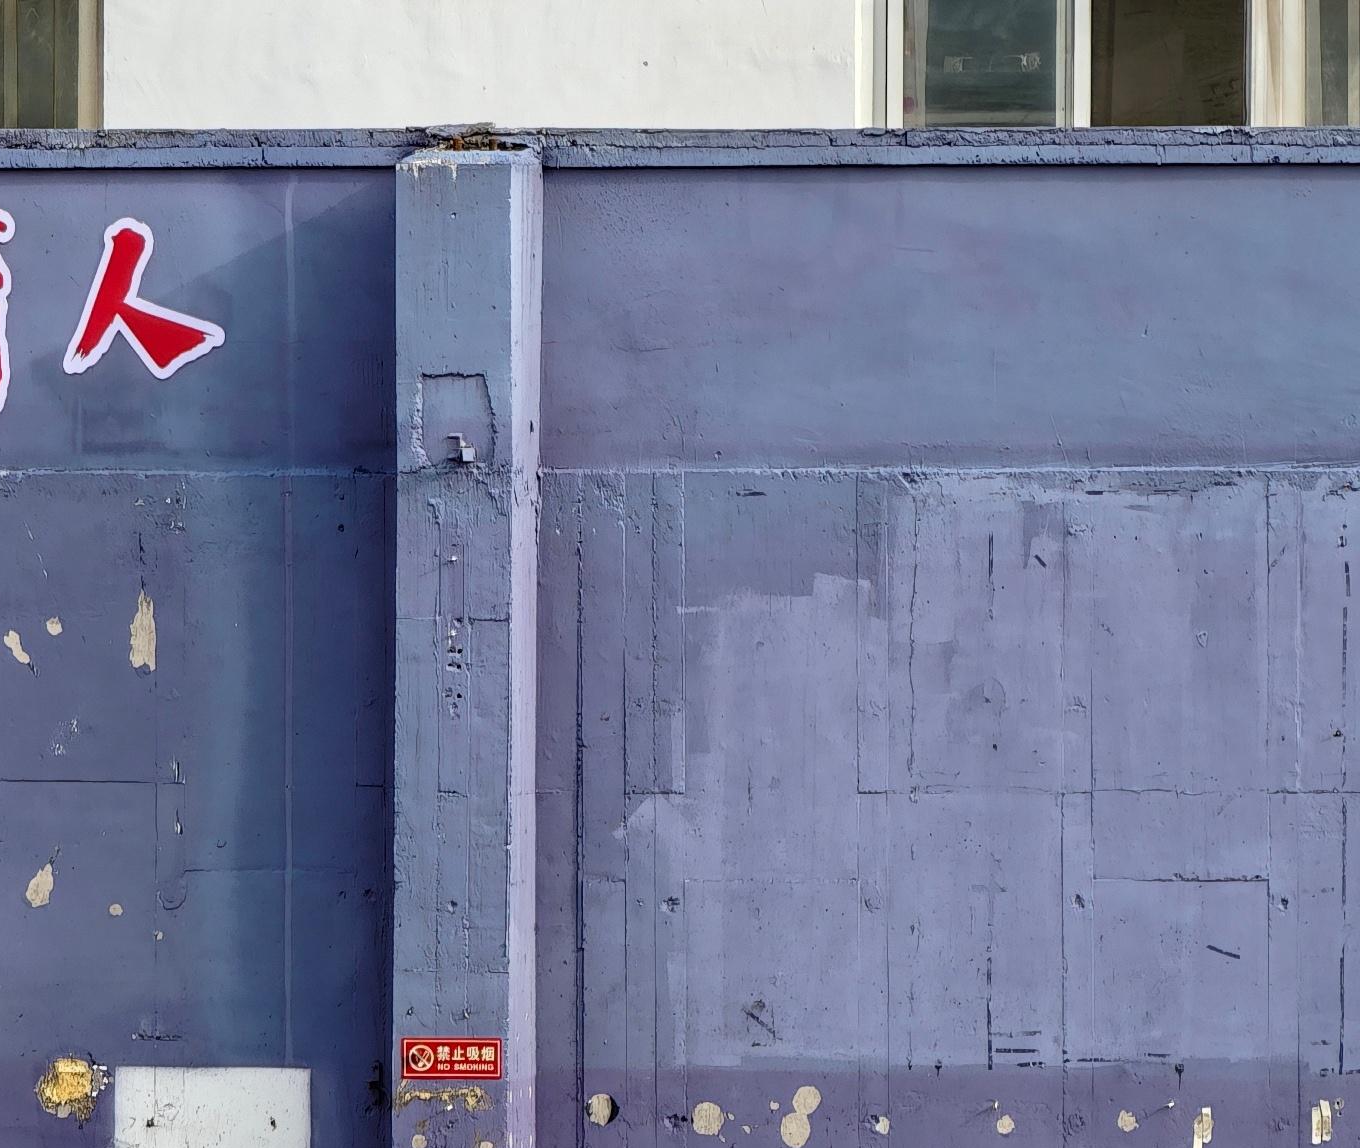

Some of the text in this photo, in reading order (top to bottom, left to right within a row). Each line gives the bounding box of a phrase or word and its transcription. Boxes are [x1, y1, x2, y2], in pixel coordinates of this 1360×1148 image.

[437, 1046, 495, 1062] 禁止吸烟
[437, 1063, 494, 1071] NO SMOKING
